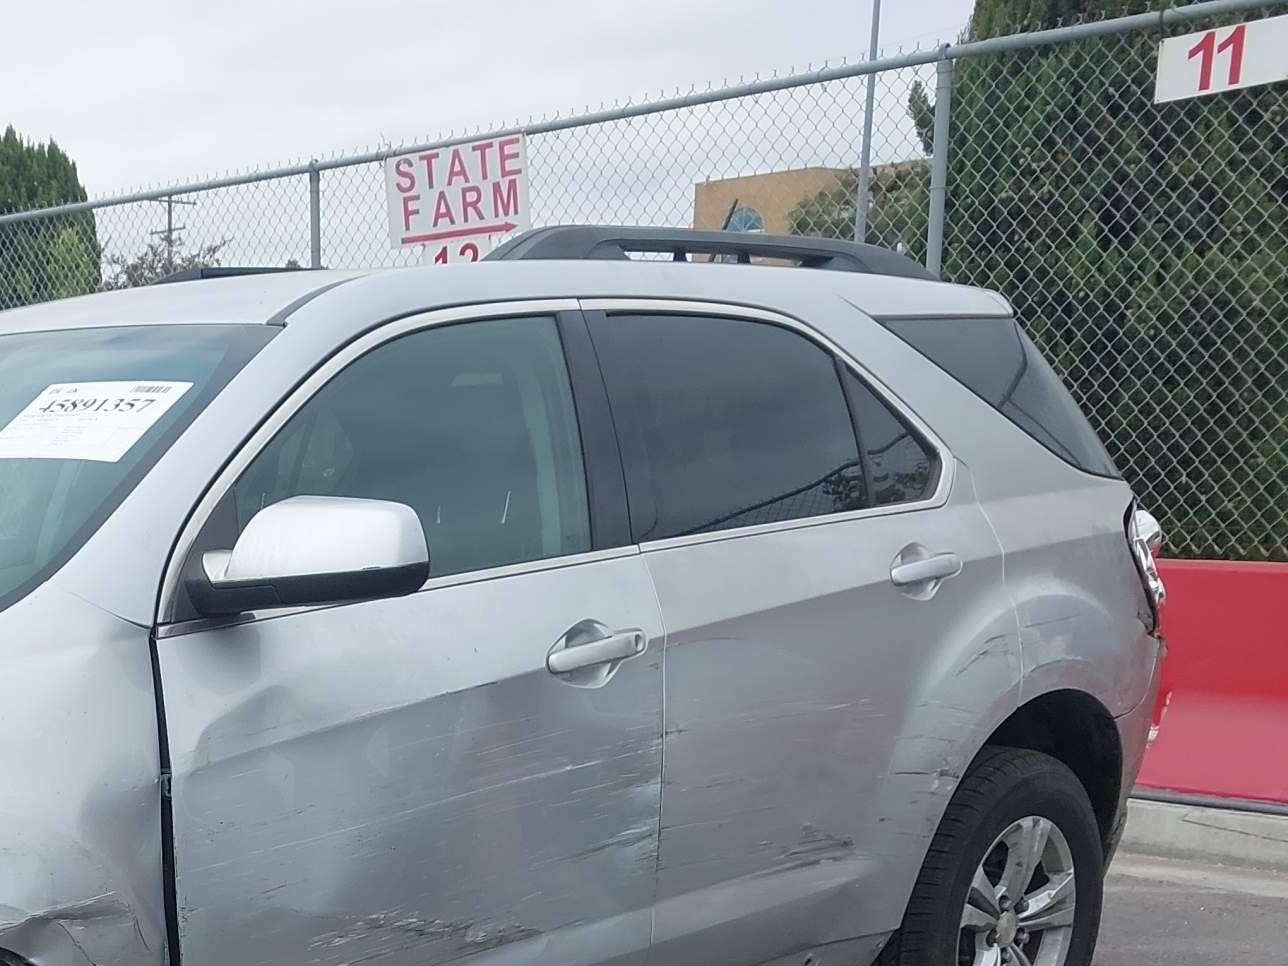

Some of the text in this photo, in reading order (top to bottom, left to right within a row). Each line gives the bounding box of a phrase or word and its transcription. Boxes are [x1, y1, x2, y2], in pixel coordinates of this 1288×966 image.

[1187, 24, 1246, 92] 11
[394, 138, 522, 194] STATE
[402, 178, 519, 231] FARM
[39, 398, 157, 412] 45891357
